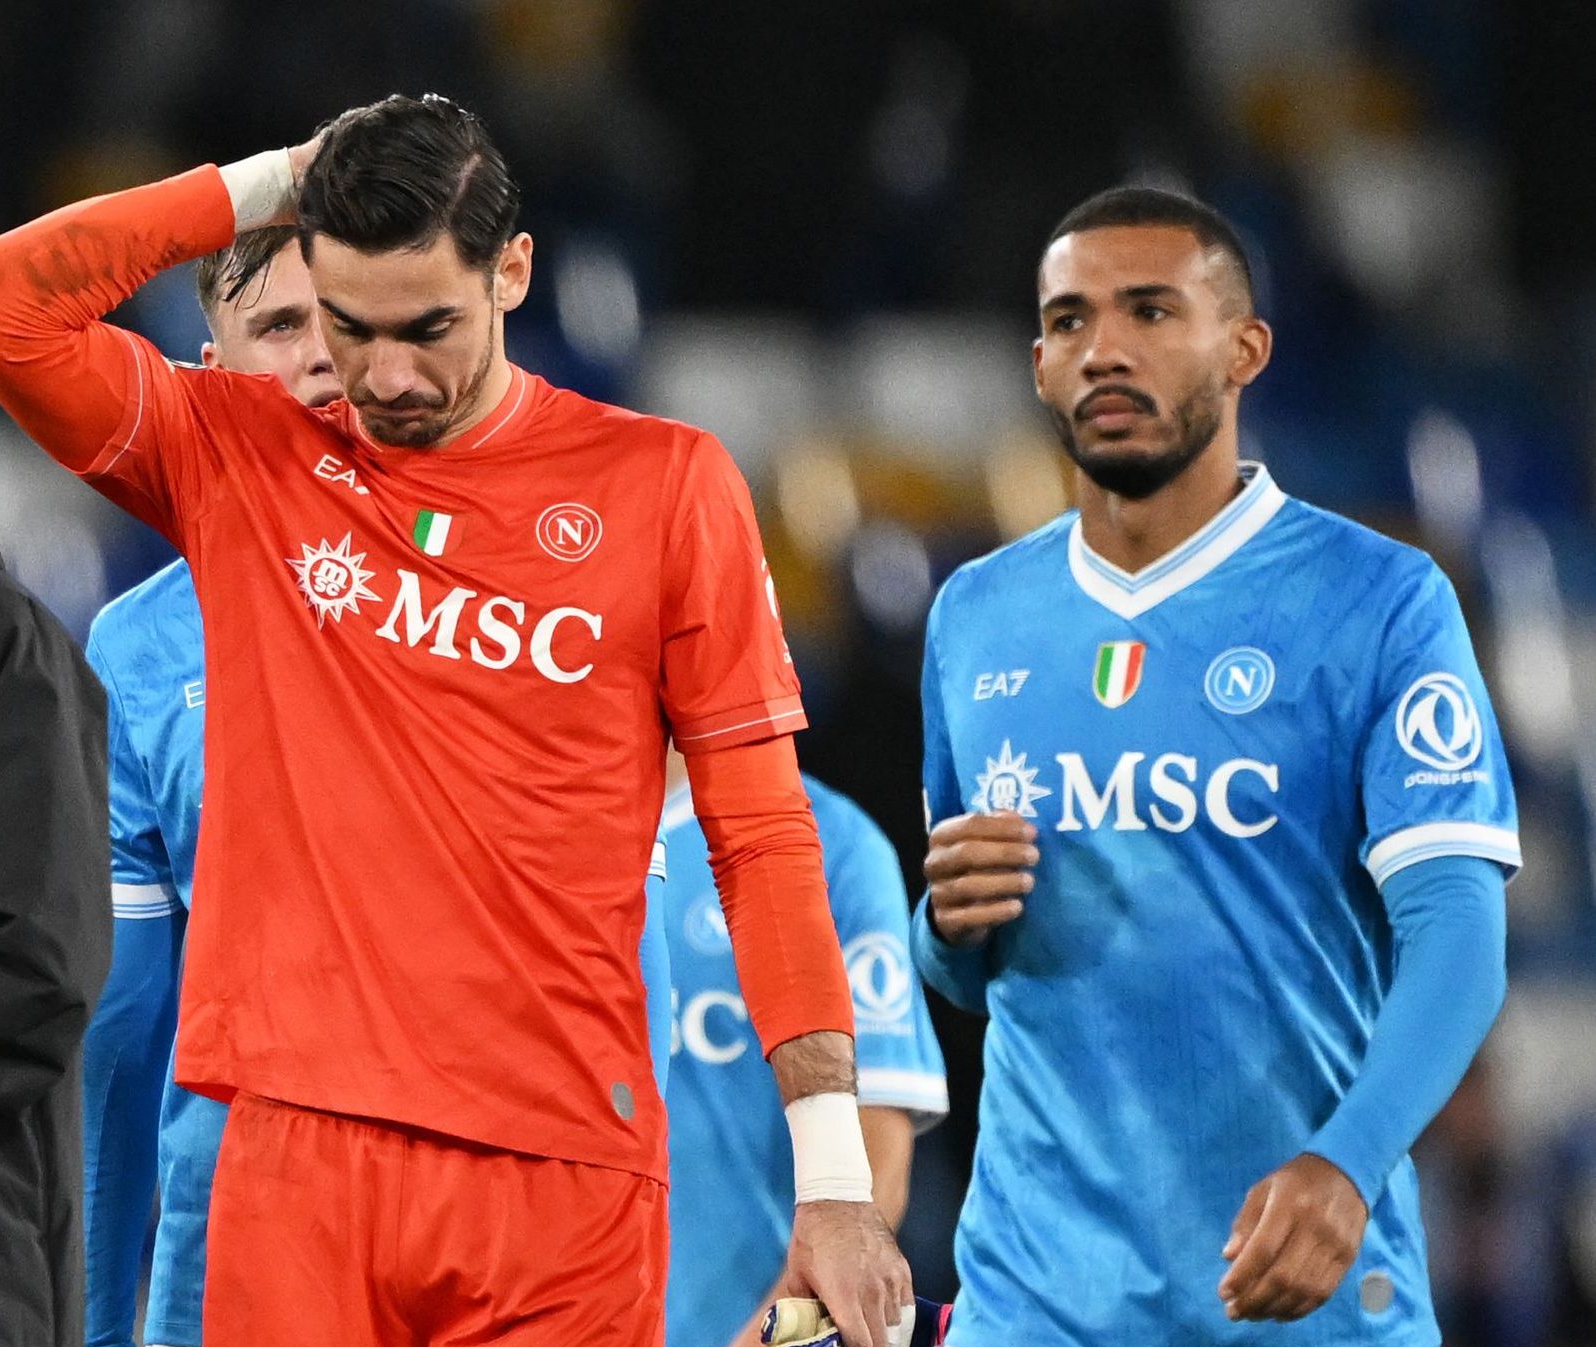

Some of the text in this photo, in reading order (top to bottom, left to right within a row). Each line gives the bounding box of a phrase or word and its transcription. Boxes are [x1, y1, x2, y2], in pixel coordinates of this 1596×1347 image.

[555, 518, 586, 547] N
[375, 569, 602, 683] MSC
[974, 670, 1031, 701] EA7
[1226, 667, 1256, 696] N
[1055, 752, 1279, 838] MSC
